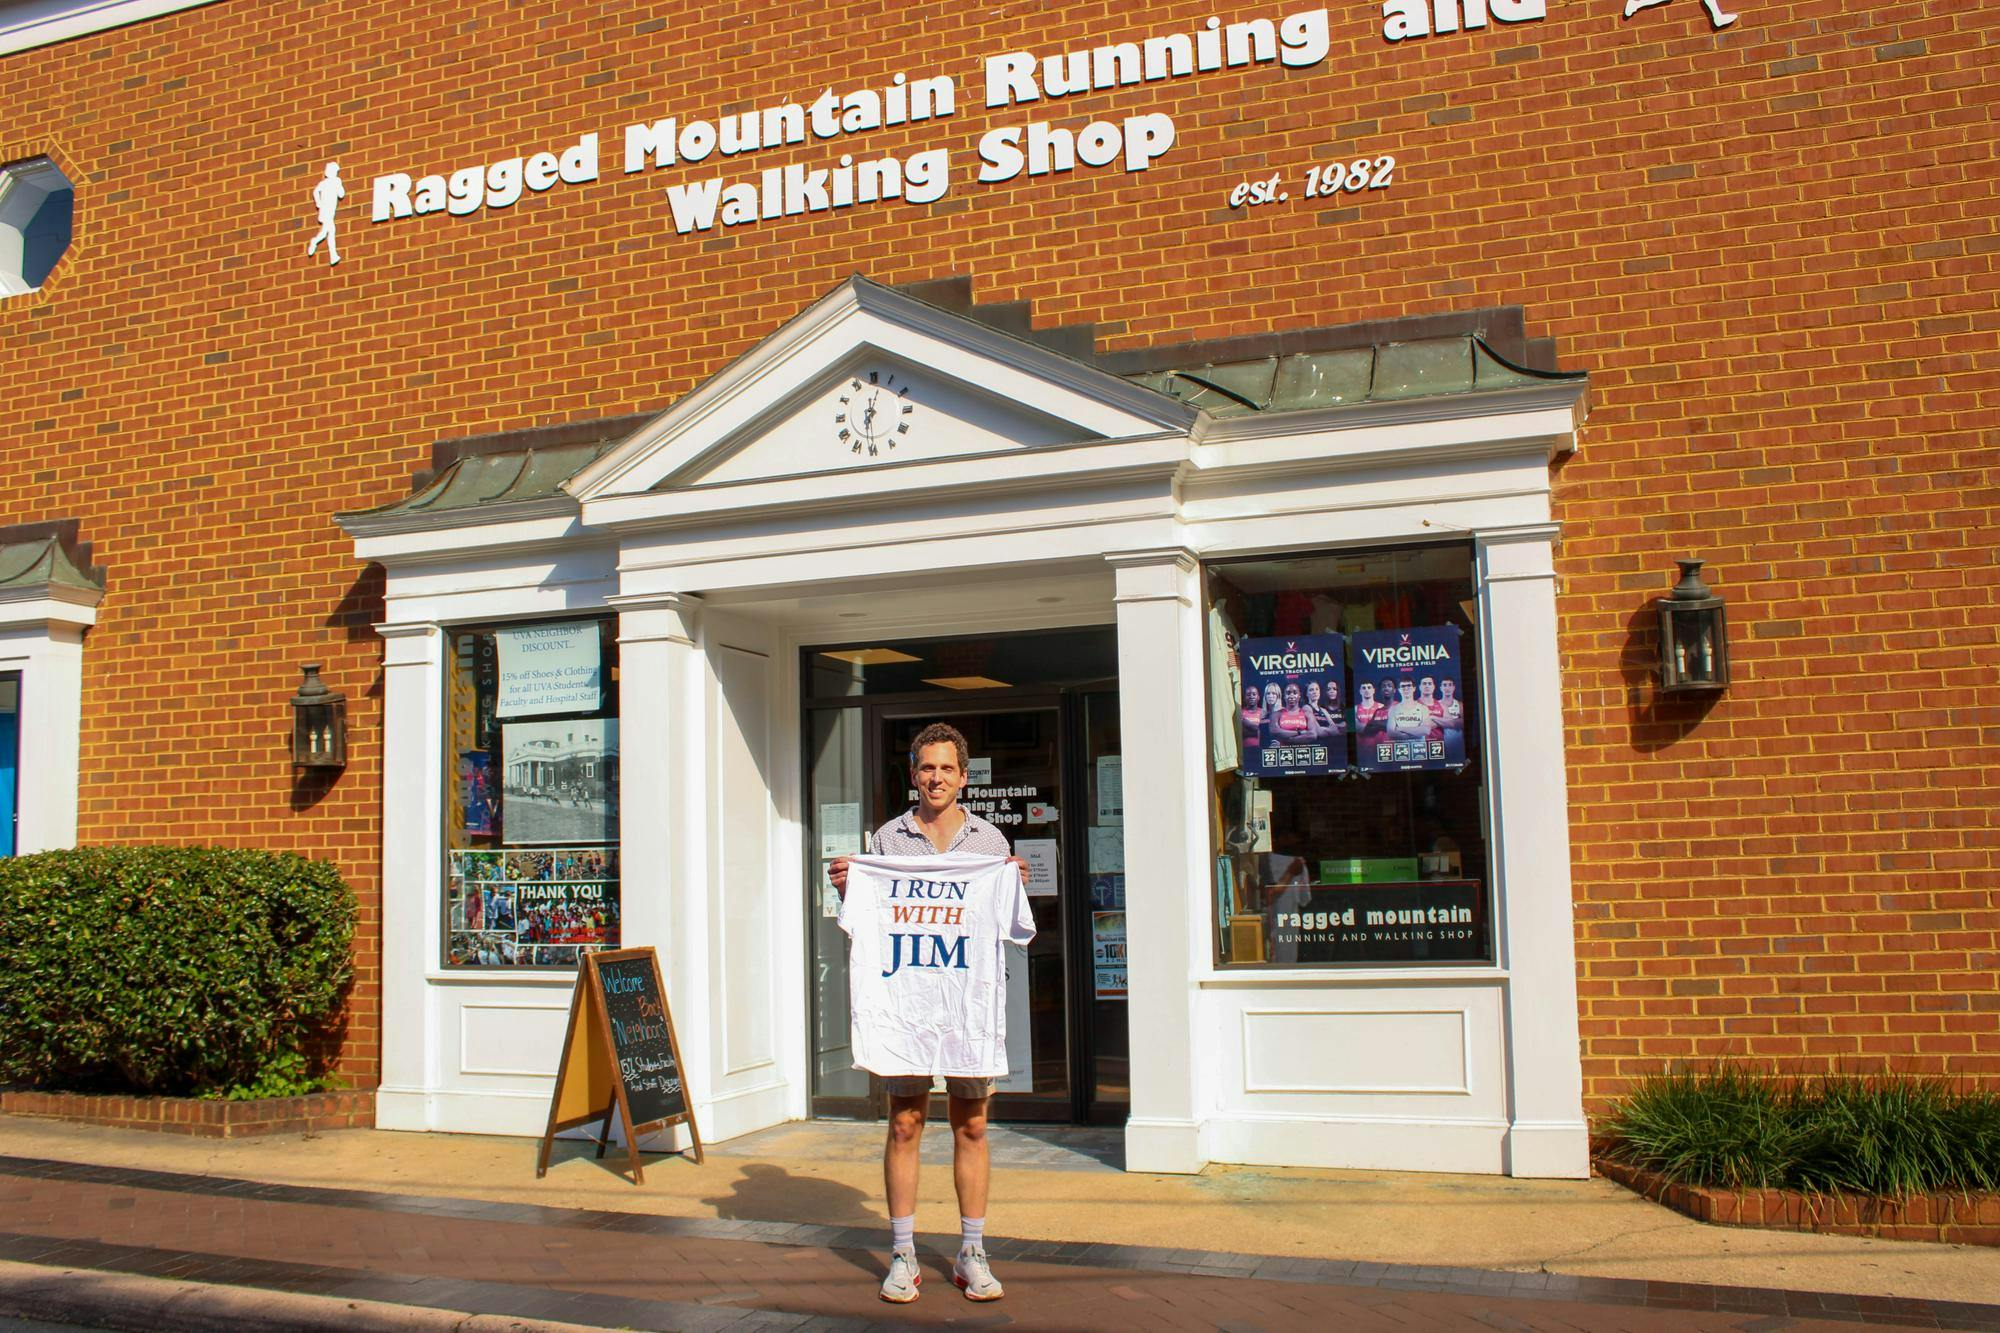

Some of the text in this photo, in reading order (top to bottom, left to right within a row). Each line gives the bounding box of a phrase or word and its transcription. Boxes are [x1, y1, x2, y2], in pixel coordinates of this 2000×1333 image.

[372, 132, 598, 223] Ragged
[624, 73, 955, 174] Mountain
[984, 8, 1330, 108] Running
[667, 112, 1176, 234] Walking Shop
[1229, 155, 1396, 209] est. 1982
[512, 626, 583, 640] UVA NEIGHBOR
[1249, 651, 1335, 671] VIRGINIA
[1362, 644, 1450, 664] VIRGINIA
[532, 670, 554, 678] Shoes
[510, 685, 520, 694] for
[522, 684, 532, 692] all
[534, 683, 552, 692] UVA
[500, 690, 597, 707] Faculty and Hospital Staff
[1265, 754, 1276, 762] 22
[1315, 752, 1325, 760] 27
[968, 784, 1037, 798] Mountain
[964, 799, 1012, 812] ning &
[986, 812, 1022, 825] Shop
[519, 885, 567, 899] THANK
[888, 879, 970, 900] I RUN
[892, 905, 965, 925] WITH
[1277, 905, 1472, 930] ragged mountain
[1278, 930, 1474, 943] RUNNING AND WALKING SHOP
[881, 933, 970, 978] JIM
[600, 967, 645, 994] Welcome
